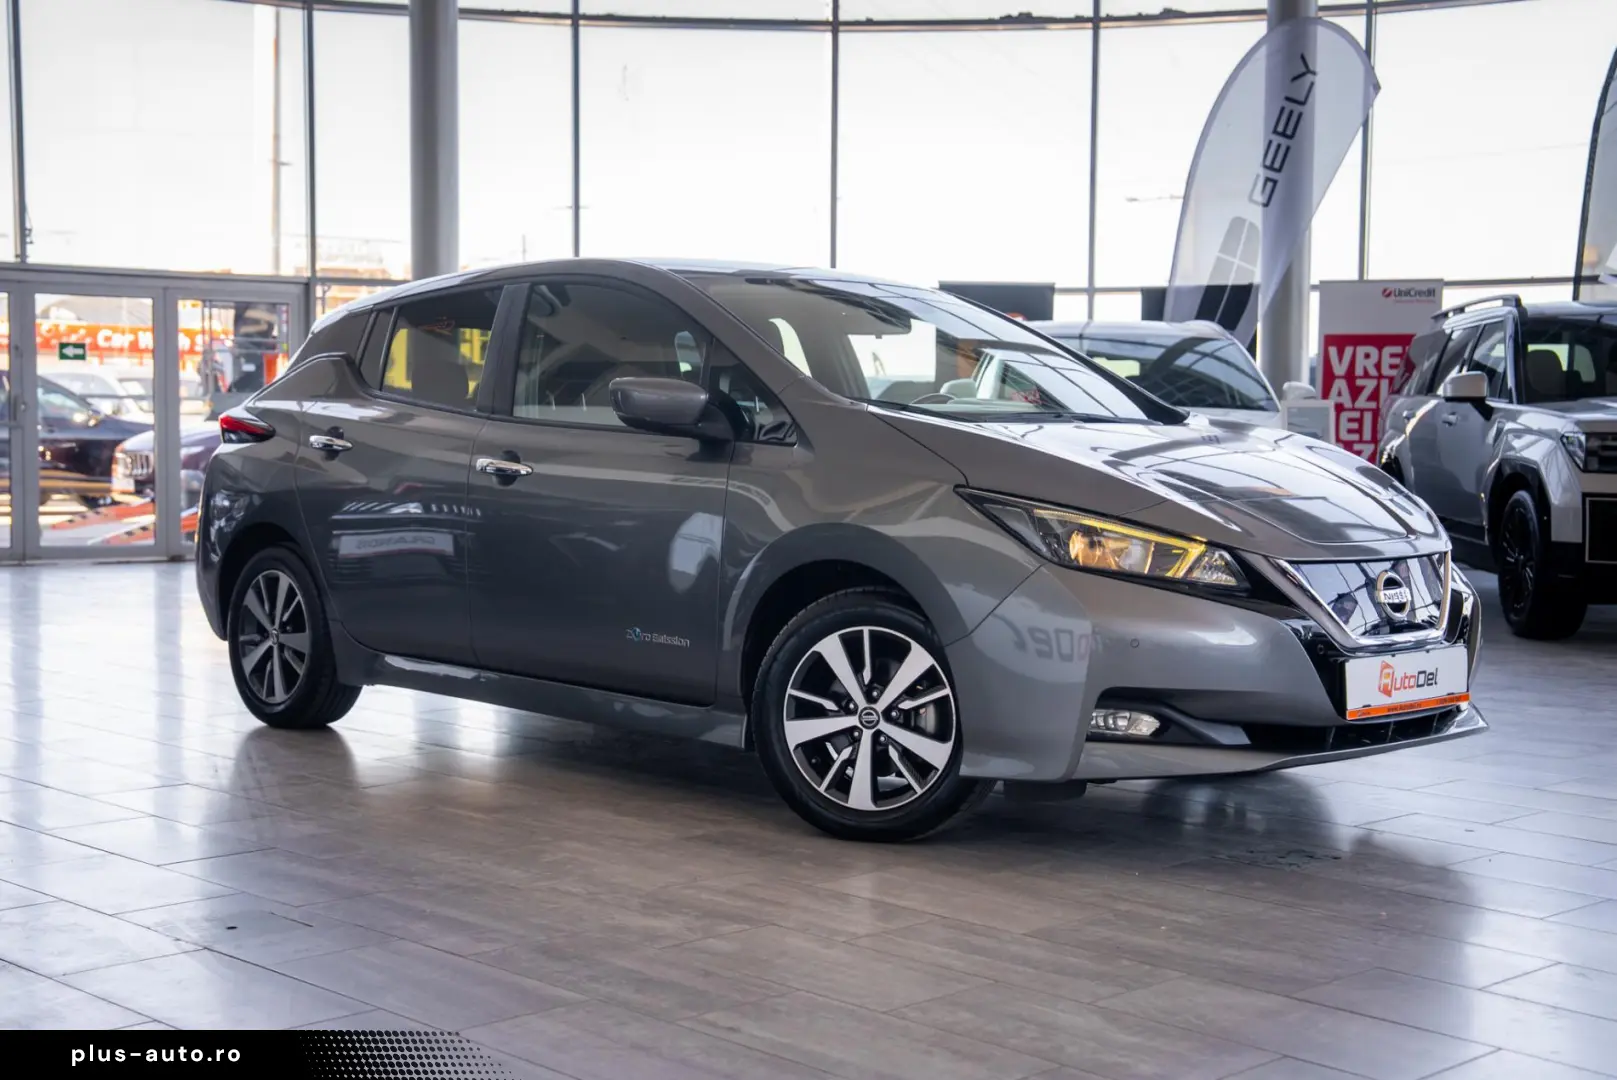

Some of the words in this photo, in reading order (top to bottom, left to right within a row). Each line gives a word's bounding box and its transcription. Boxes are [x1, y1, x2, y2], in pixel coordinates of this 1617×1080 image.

[1248, 52, 1318, 208] GEELY
[1394, 288, 1436, 298] UniCredit
[96, 328, 135, 349] Car
